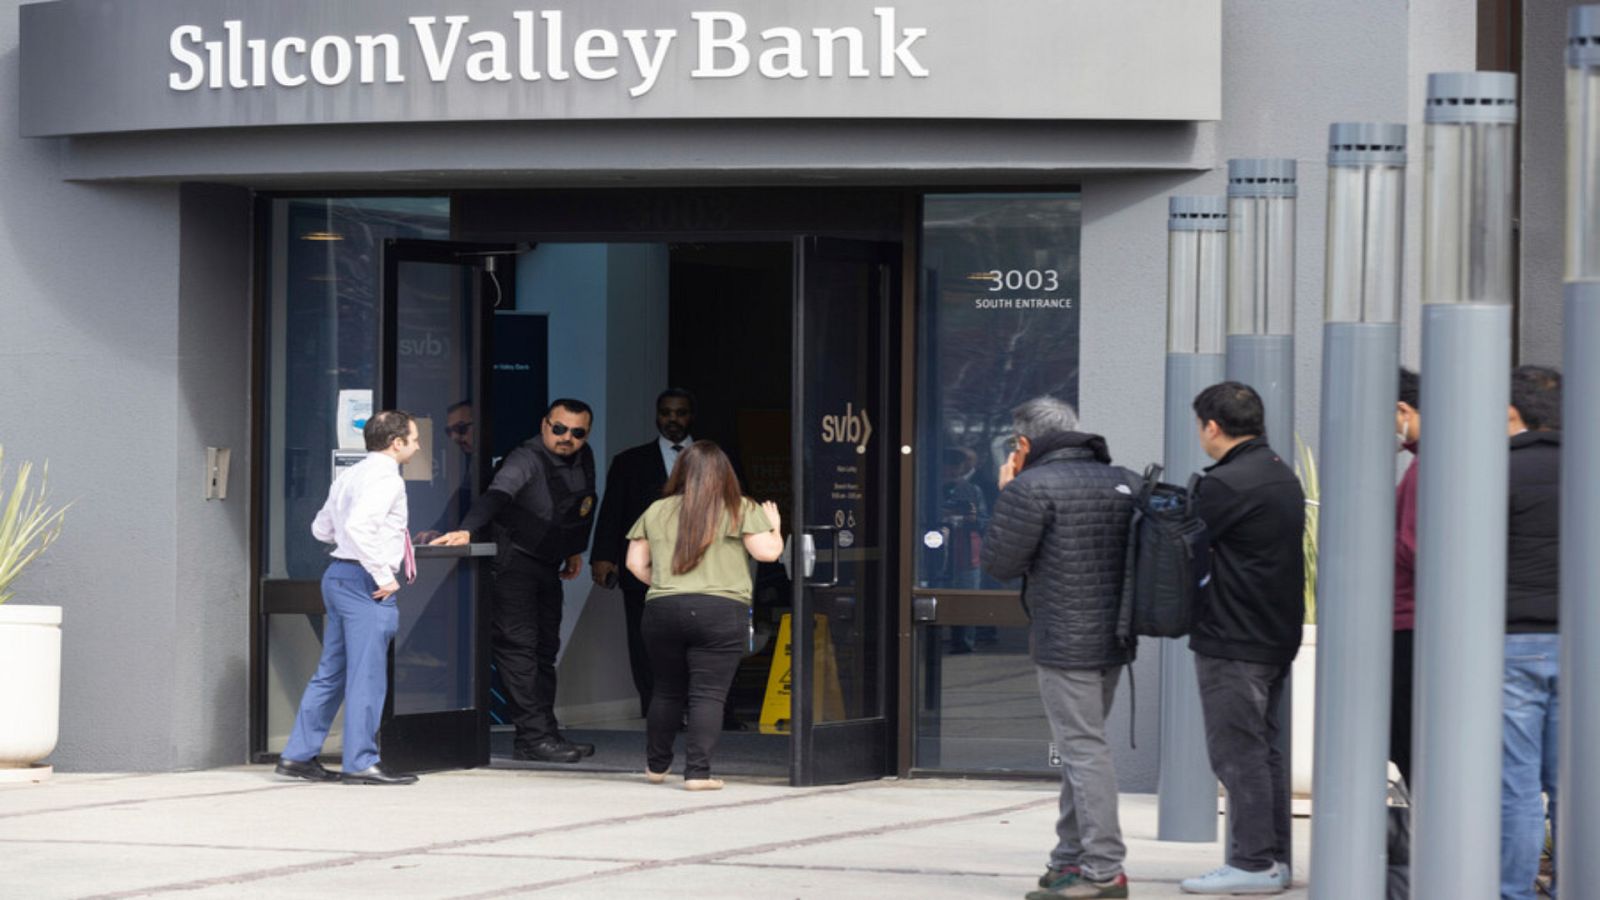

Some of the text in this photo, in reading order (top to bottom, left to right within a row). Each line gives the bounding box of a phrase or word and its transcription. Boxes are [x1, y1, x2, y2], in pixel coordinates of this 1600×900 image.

[168, 7, 929, 98] Silicon Valley Bank
[988, 269, 1060, 292] 3003
[975, 298, 1073, 309] SOUTH ENTRANCE
[822, 402, 861, 443] svb
